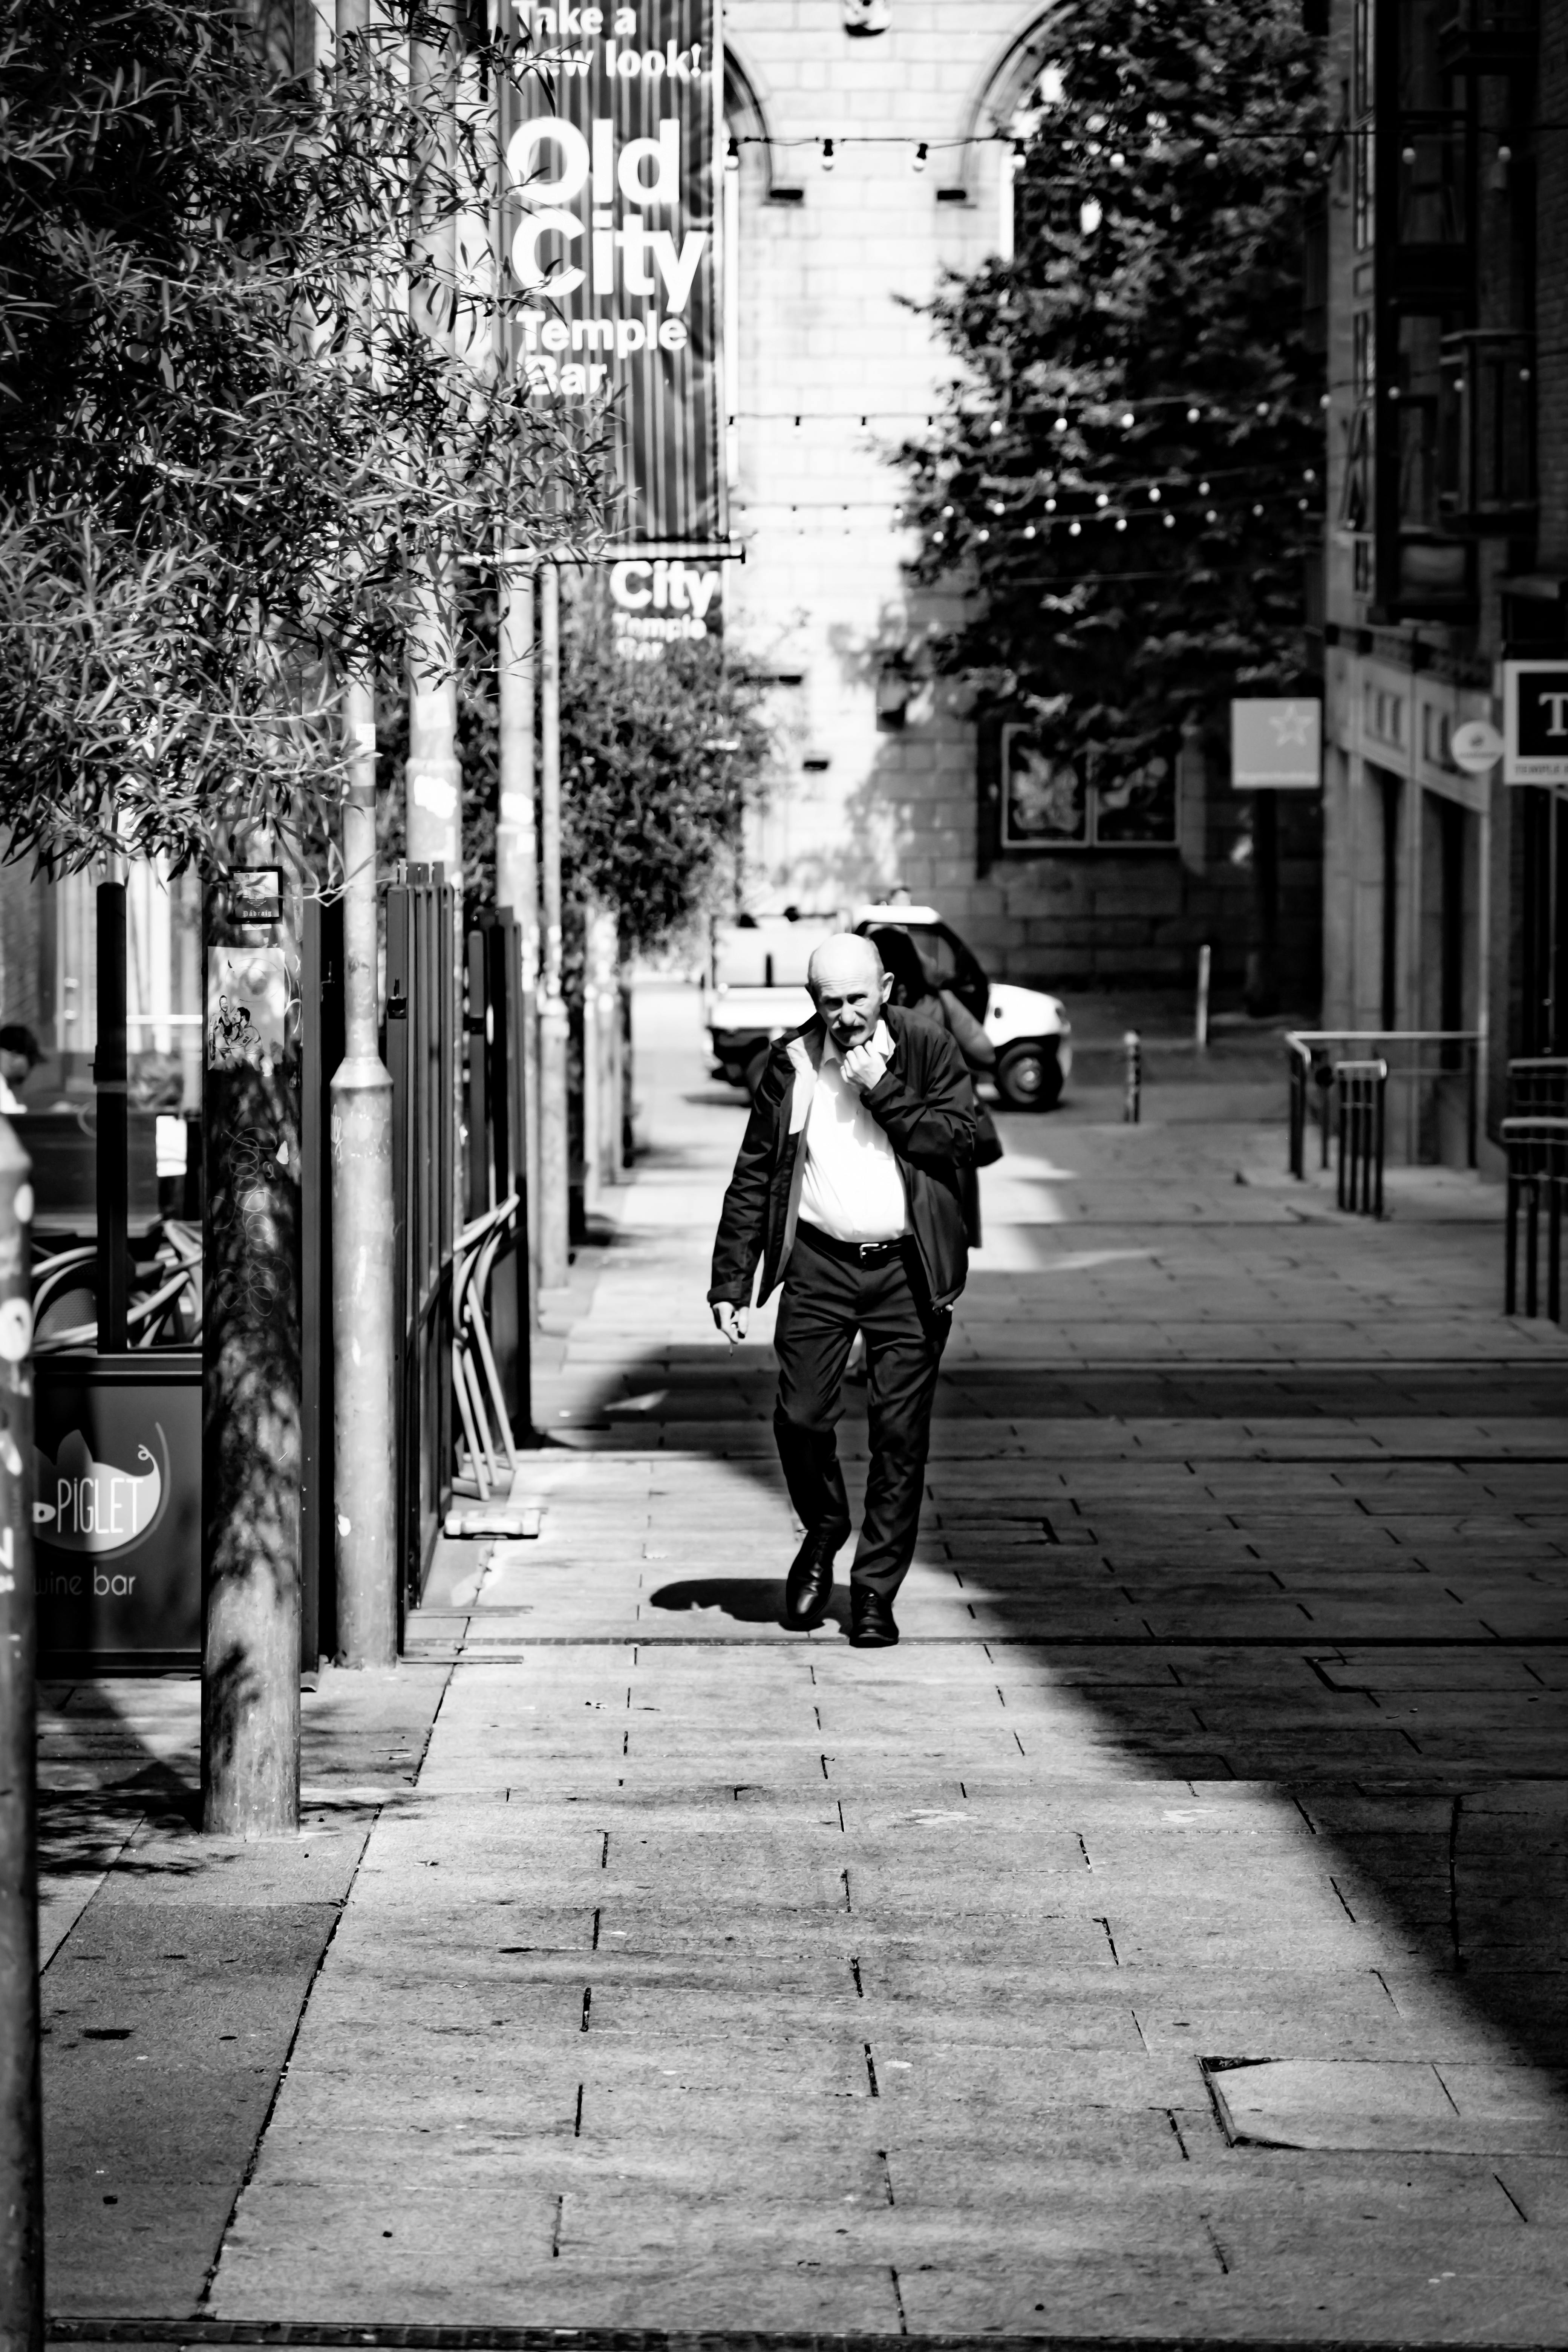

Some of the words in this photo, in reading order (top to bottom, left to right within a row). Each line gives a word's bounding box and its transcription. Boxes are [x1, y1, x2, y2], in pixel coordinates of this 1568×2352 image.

[511, 0, 603, 35] Take
[614, 7, 637, 36] a
[606, 39, 702, 82] look!
[507, 116, 680, 205] Old
[511, 208, 707, 312] City
[516, 309, 688, 359] Temple
[525, 355, 607, 395] Bar
[609, 560, 719, 619] City
[93, 1566, 136, 1596] bar
